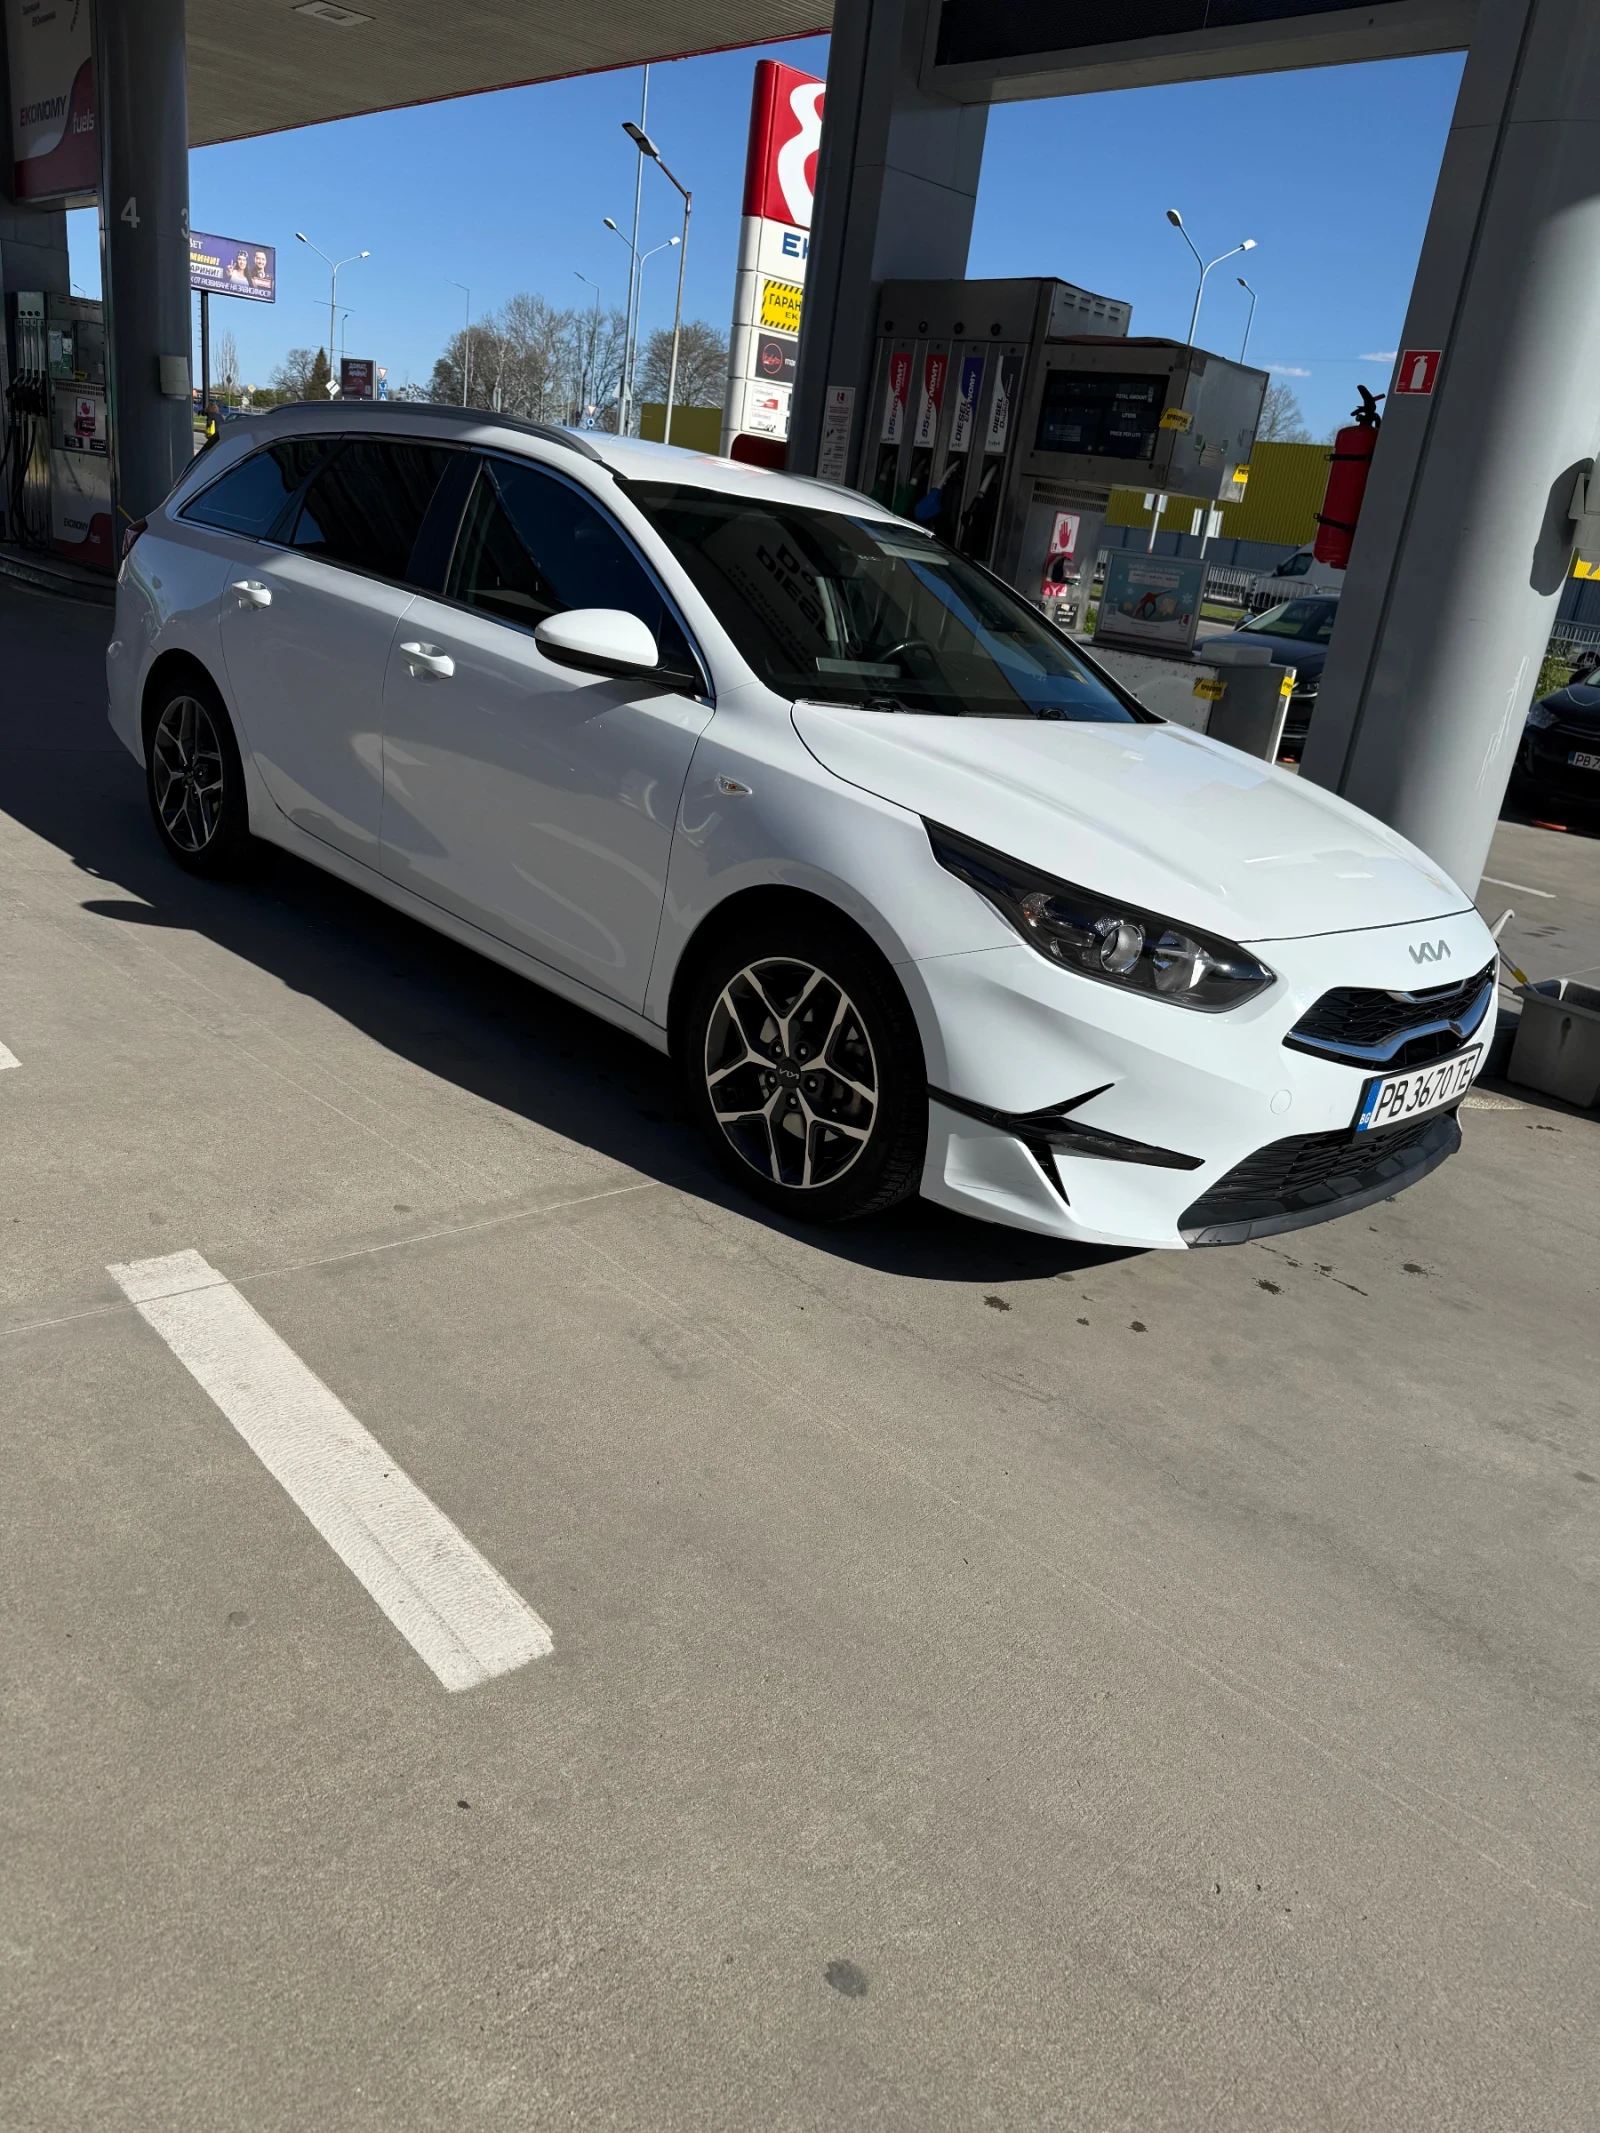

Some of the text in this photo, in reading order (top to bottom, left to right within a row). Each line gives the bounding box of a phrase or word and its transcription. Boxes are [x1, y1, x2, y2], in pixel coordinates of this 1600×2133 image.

[20, 95, 67, 127] EKONOMY
[73, 108, 95, 134] fuels
[121, 196, 140, 228] 4
[181, 208, 190, 239] 3
[964, 371, 977, 422] EKONOMY
[956, 400, 968, 441] DIESEL
[992, 398, 1003, 434] DIESEL
[1575, 754, 1591, 767] PB
[1409, 940, 1451, 965] KIA
[1374, 1054, 1477, 1122] PB 3670 TE
[1359, 1112, 1371, 1125] BG
